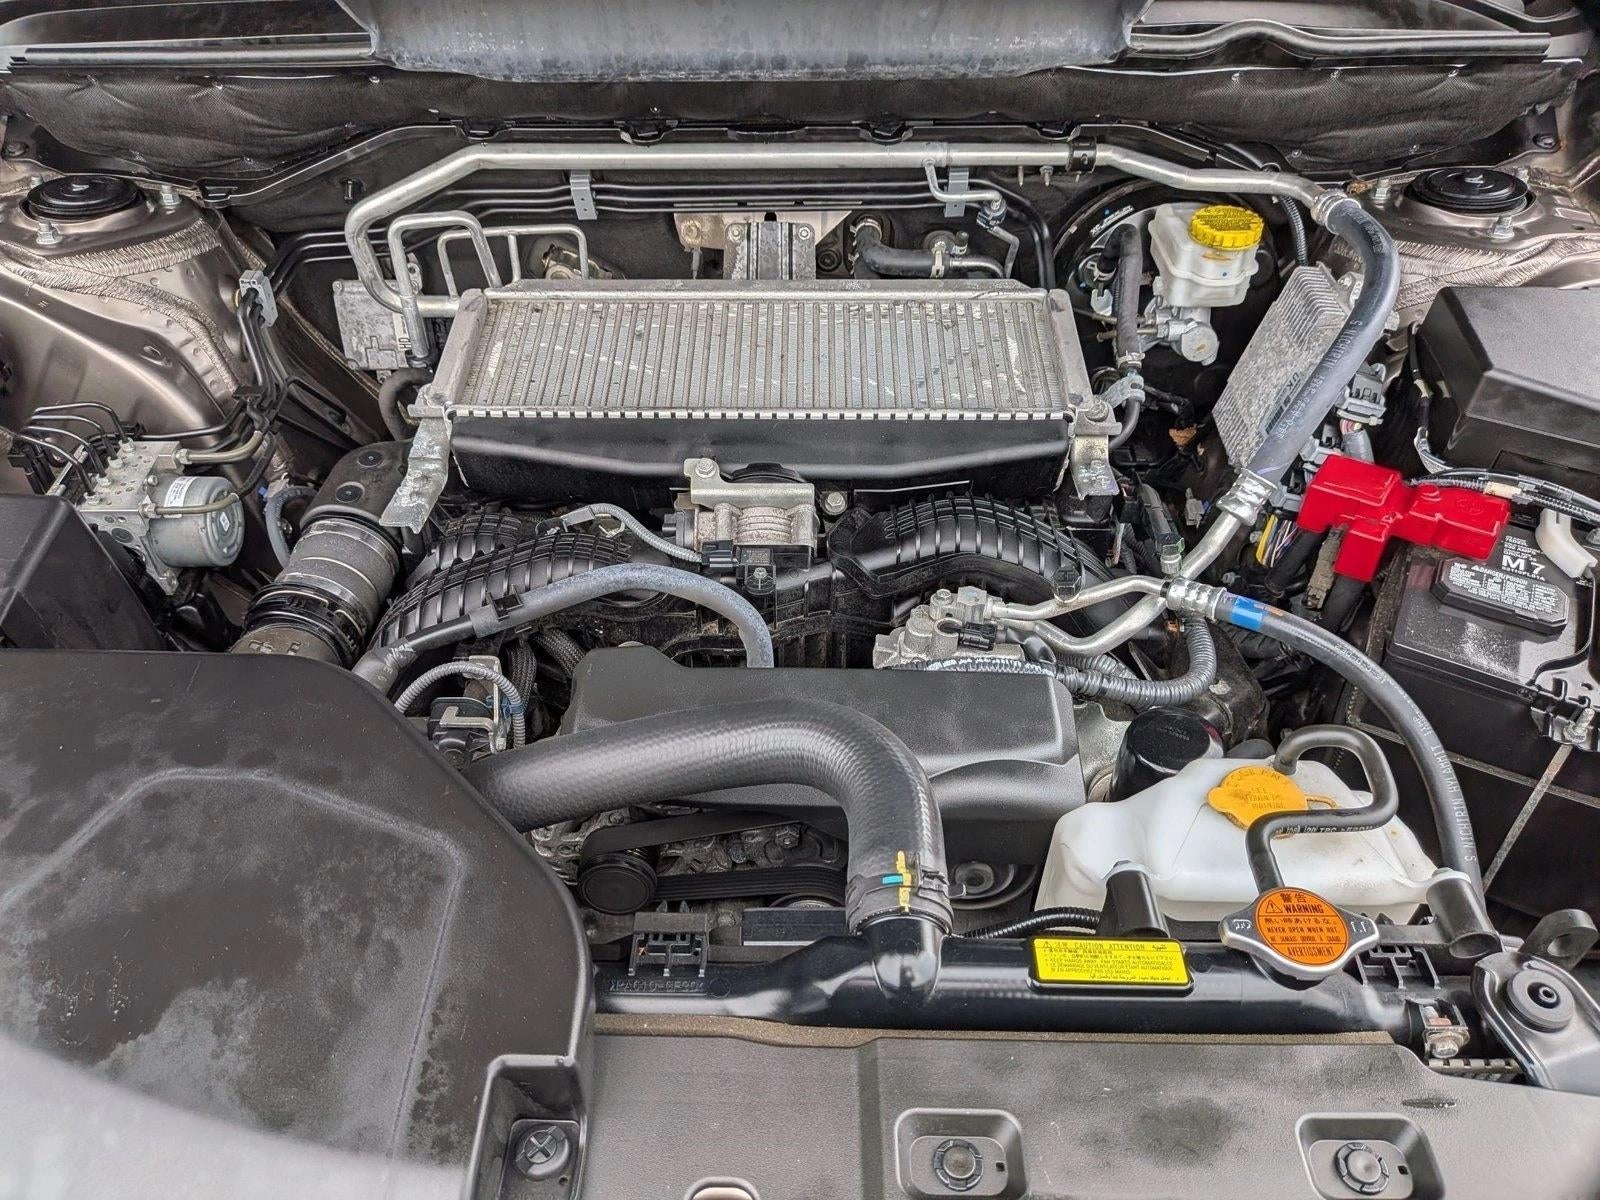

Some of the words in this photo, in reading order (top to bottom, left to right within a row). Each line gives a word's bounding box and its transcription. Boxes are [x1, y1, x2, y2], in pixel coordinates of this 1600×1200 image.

[1502, 556, 1525, 571] M
[1530, 562, 1546, 574] 7
[1280, 892, 1307, 904] 警告
[1283, 903, 1325, 914] WARNING
[1266, 926, 1286, 934] NEVER
[1288, 926, 1305, 934] OPEN
[1306, 926, 1325, 934] WHEN
[1074, 942, 1105, 951] CAUTION
